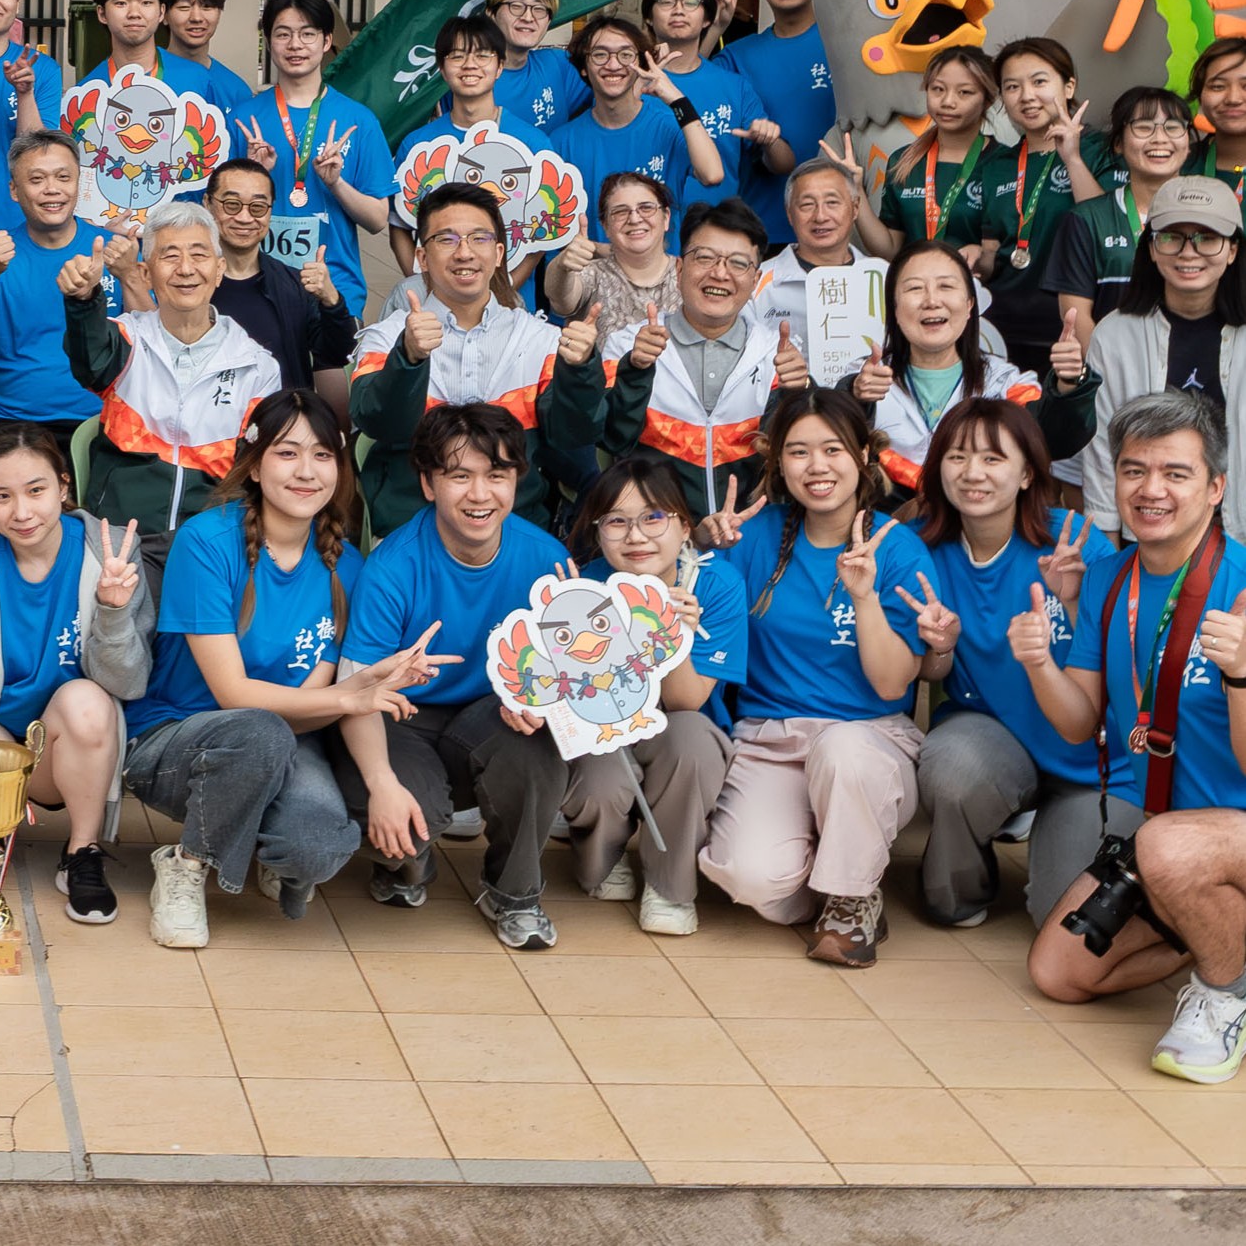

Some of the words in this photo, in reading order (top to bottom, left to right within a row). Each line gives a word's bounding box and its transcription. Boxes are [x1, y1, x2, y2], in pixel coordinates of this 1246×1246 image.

[716, 104, 732, 136] 樹仁
[818, 277, 851, 341] 樹仁
[212, 368, 236, 406] 樹仁
[831, 602, 857, 647] 社工
[288, 628, 314, 671] 社工
